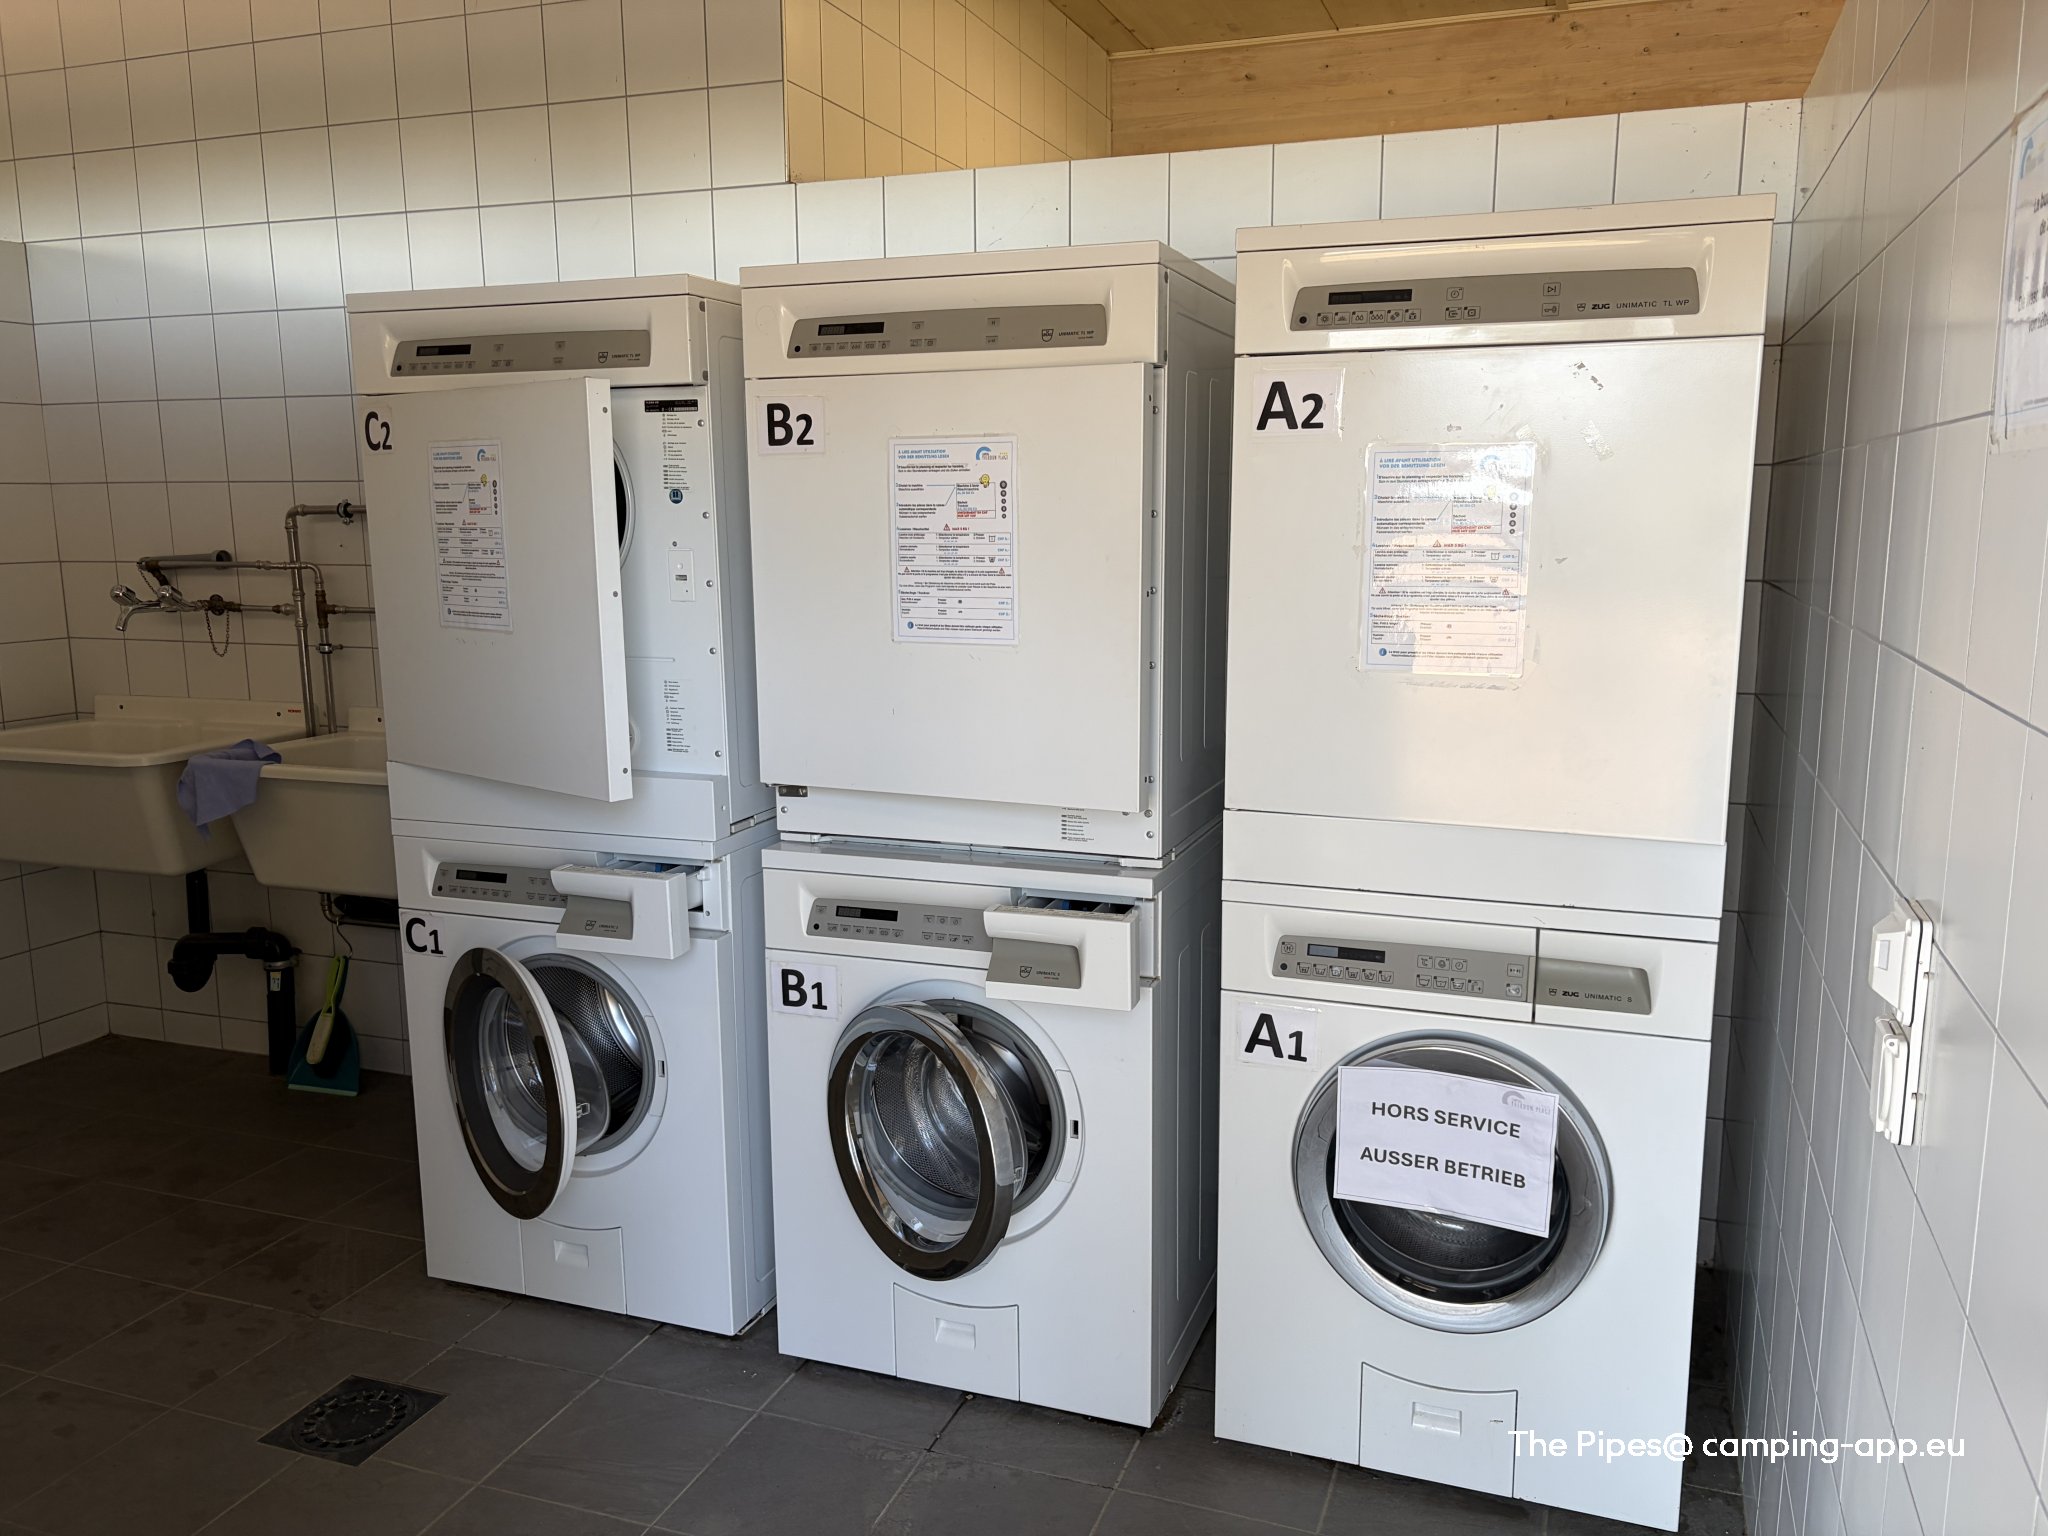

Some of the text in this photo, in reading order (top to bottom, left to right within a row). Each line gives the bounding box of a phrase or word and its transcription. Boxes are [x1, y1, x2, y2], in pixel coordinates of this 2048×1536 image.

[1616, 300, 1657, 309] UNIMATIC
[767, 402, 815, 446] B2
[1256, 381, 1324, 430] A2
[364, 411, 393, 452] C2
[405, 917, 443, 955] C1
[781, 968, 828, 1010] B1
[1561, 990, 1580, 998] ZUG
[1584, 992, 1622, 1002] UNIMATIC
[1244, 1012, 1307, 1062] A1
[1371, 1101, 1521, 1138] HORS SERVICE
[1360, 1146, 1526, 1189] AUSSER BETRIEB
